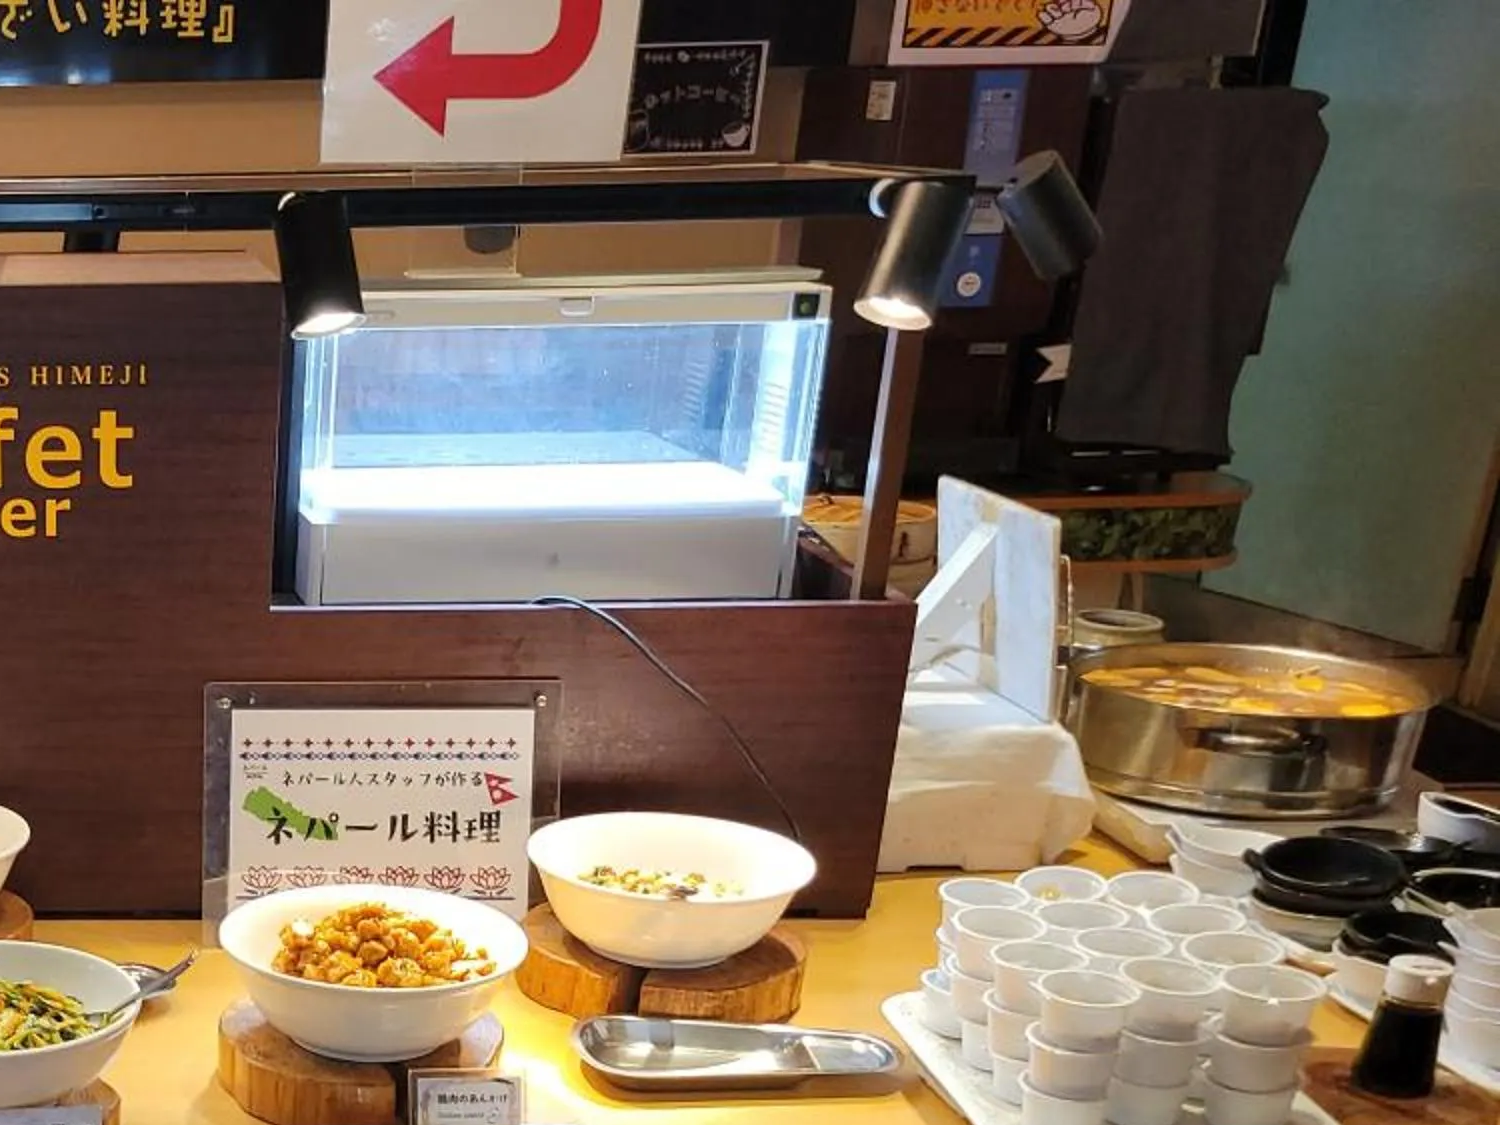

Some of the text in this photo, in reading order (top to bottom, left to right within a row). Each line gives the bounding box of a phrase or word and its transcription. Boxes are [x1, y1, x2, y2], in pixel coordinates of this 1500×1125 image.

[31, 364, 147, 385] HIMEJI
[283, 770, 483, 787] ネパール人スタッフが作る
[266, 806, 501, 845] ネパール料理
